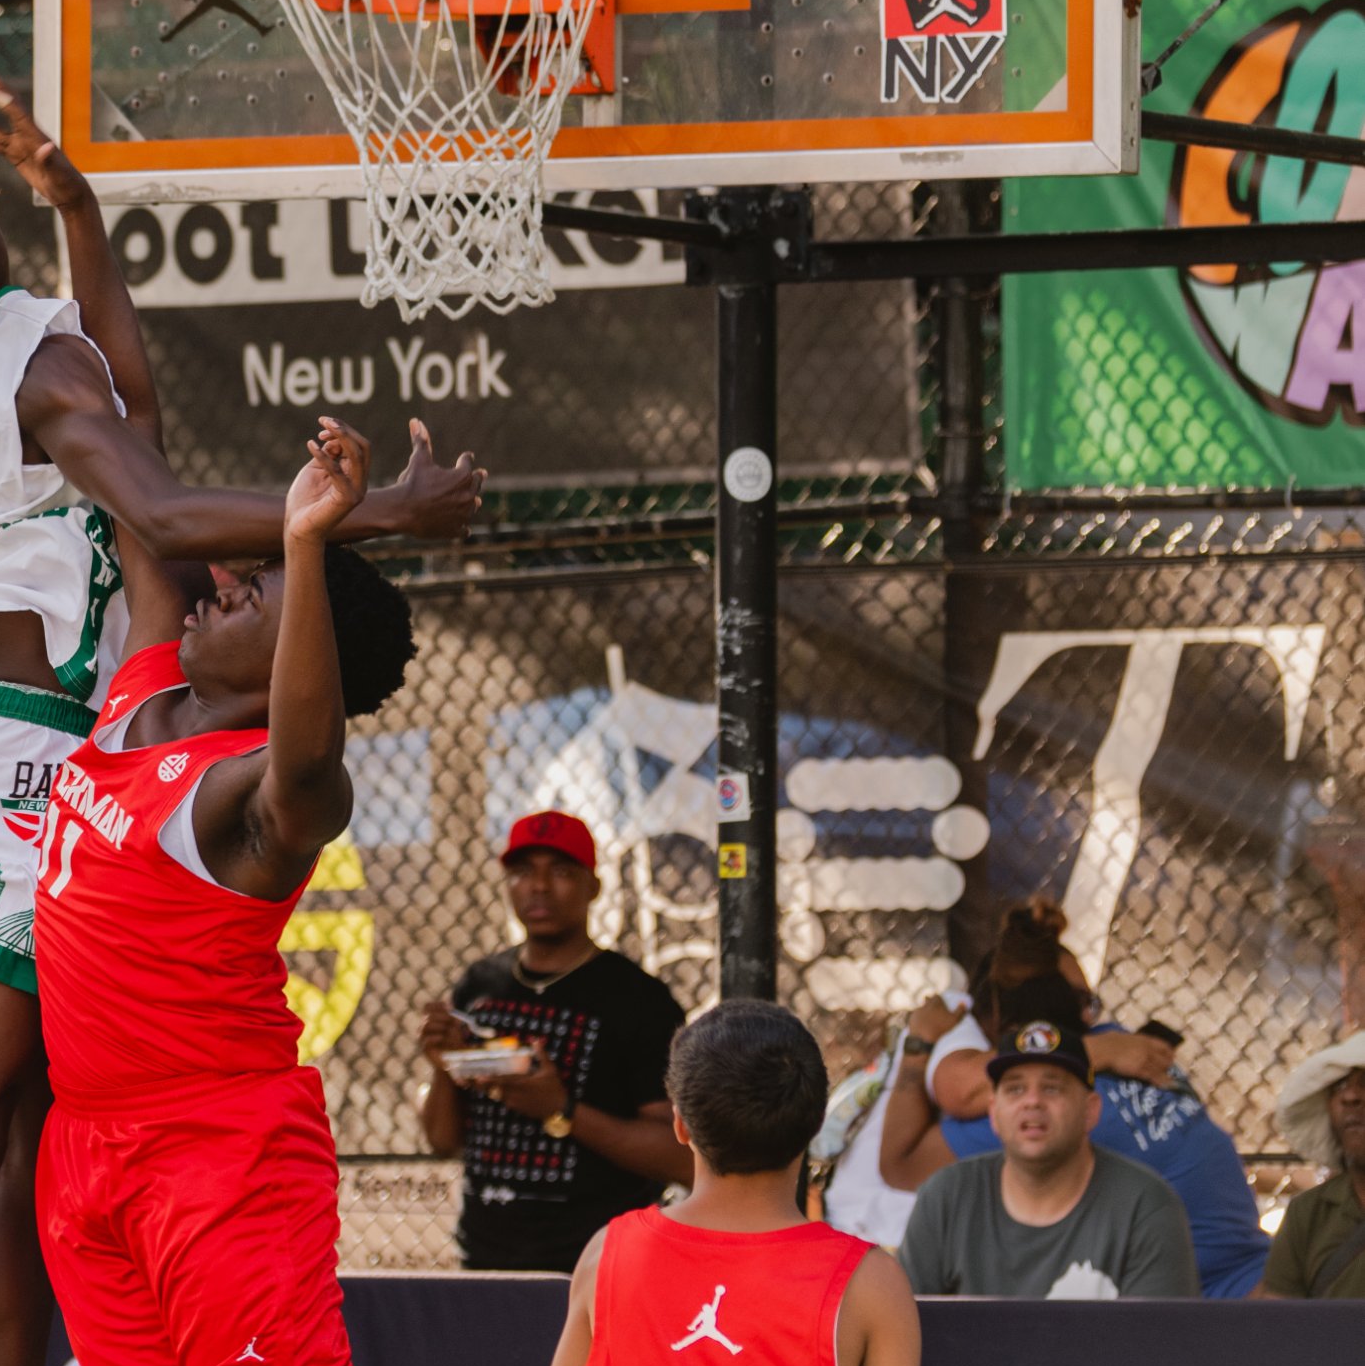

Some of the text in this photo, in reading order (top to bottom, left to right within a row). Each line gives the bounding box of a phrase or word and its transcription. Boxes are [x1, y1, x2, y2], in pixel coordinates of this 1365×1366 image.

[881, 34, 1005, 103] NY
[110, 199, 285, 286] oot
[243, 334, 511, 407] New York
